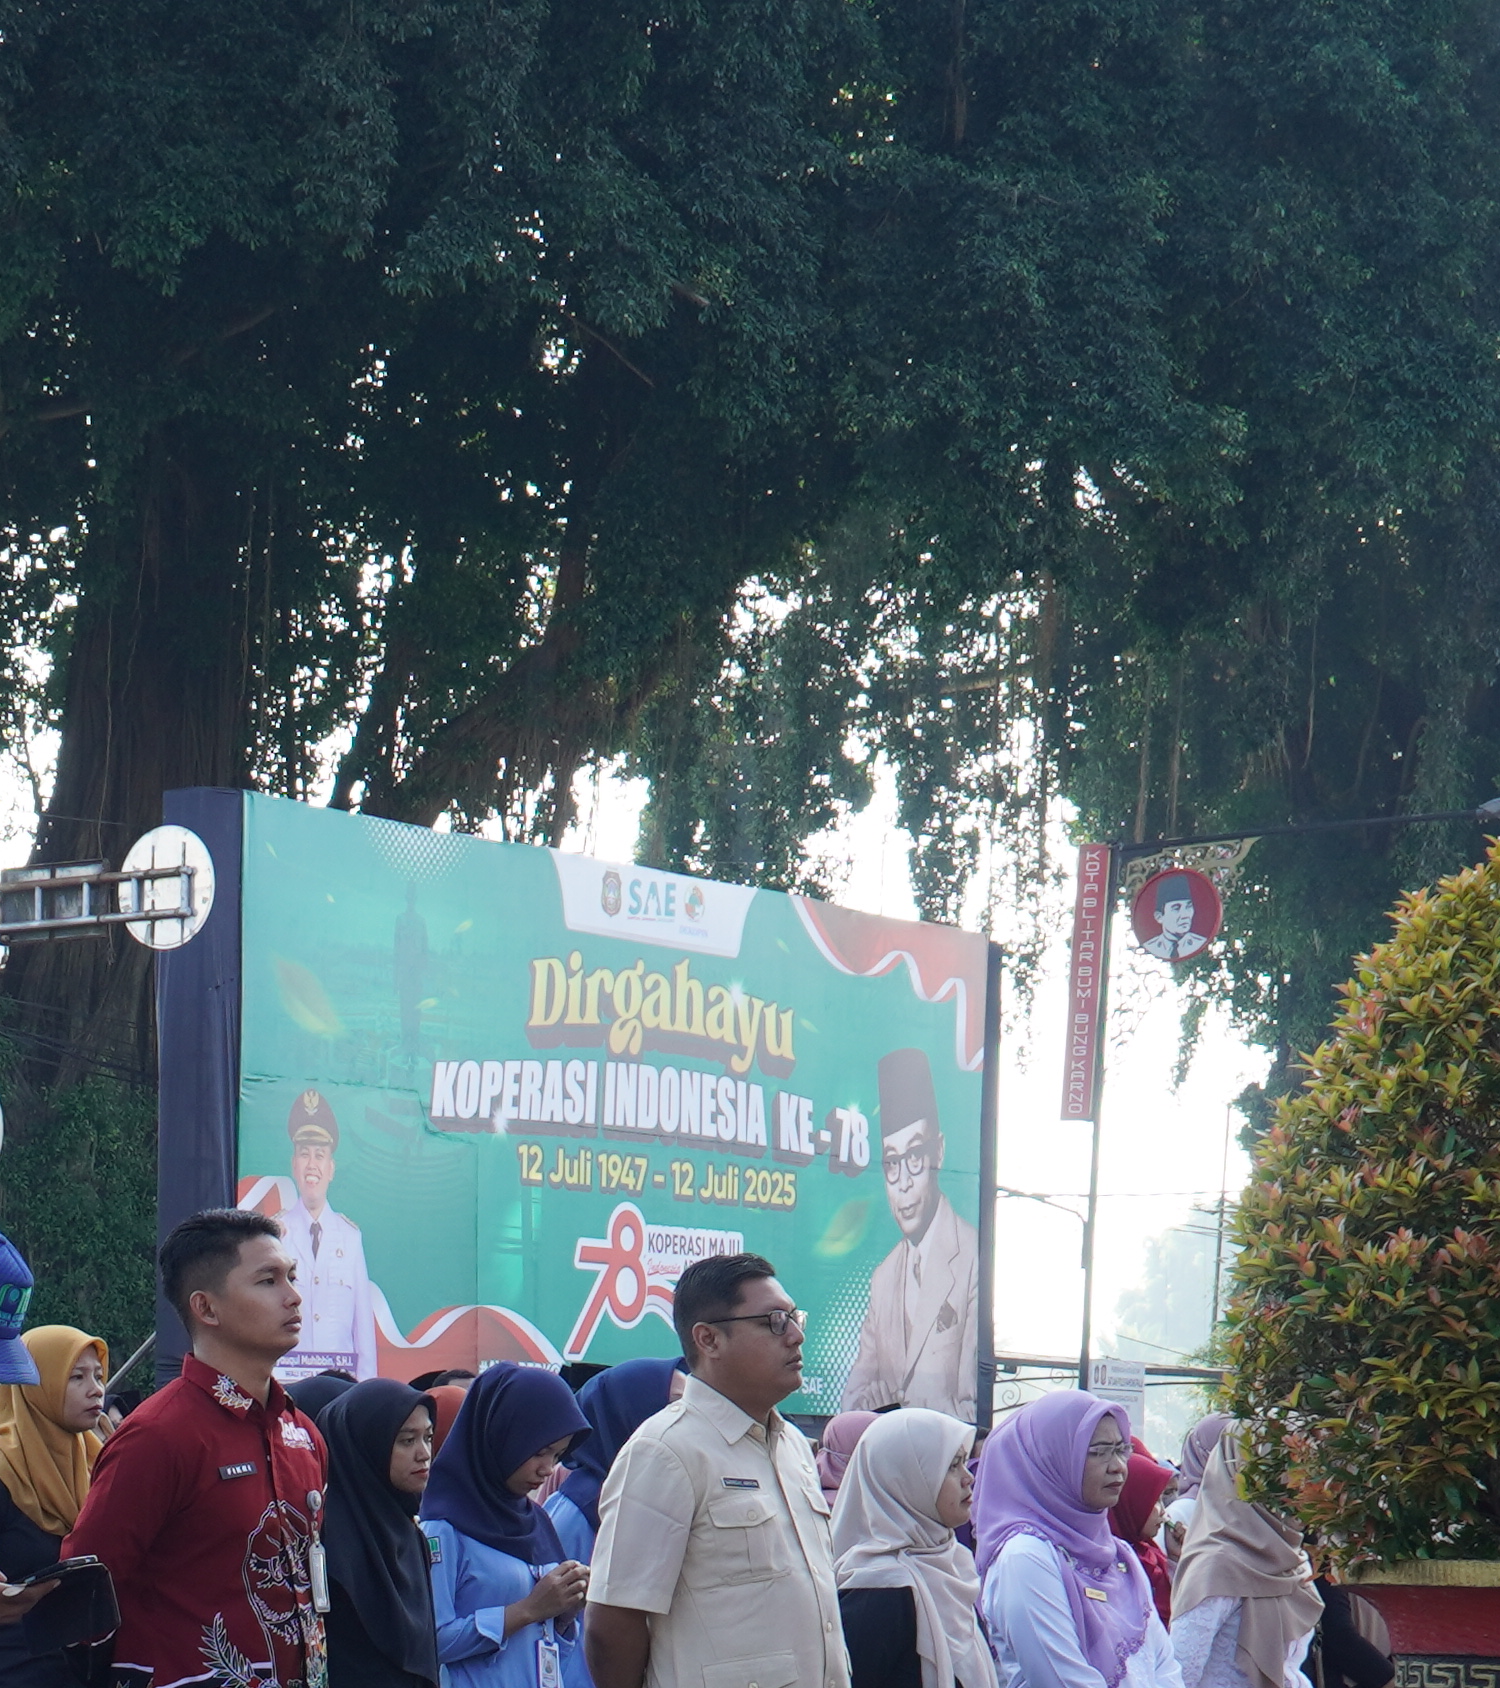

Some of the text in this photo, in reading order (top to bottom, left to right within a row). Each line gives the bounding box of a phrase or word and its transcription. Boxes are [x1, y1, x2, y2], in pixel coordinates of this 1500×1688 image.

[628, 878, 677, 917] SAE
[1068, 850, 1101, 1114] KOTA BLITAR BUMI BUNG KARNO
[528, 950, 796, 1074] Dirgahayu
[431, 1059, 599, 1126] KOPERASI
[602, 1061, 768, 1147] INDONESIA
[518, 1143, 543, 1181] 12
[550, 1147, 591, 1187] Juli
[598, 1152, 648, 1191] 1947
[671, 1161, 694, 1197] 12
[700, 1165, 739, 1200] Juli
[743, 1169, 796, 1206] 2025
[647, 1231, 740, 1257] KOPERASI MAJU
[801, 1377, 823, 1395] SAE
[227, 1464, 252, 1476] FIKRI
